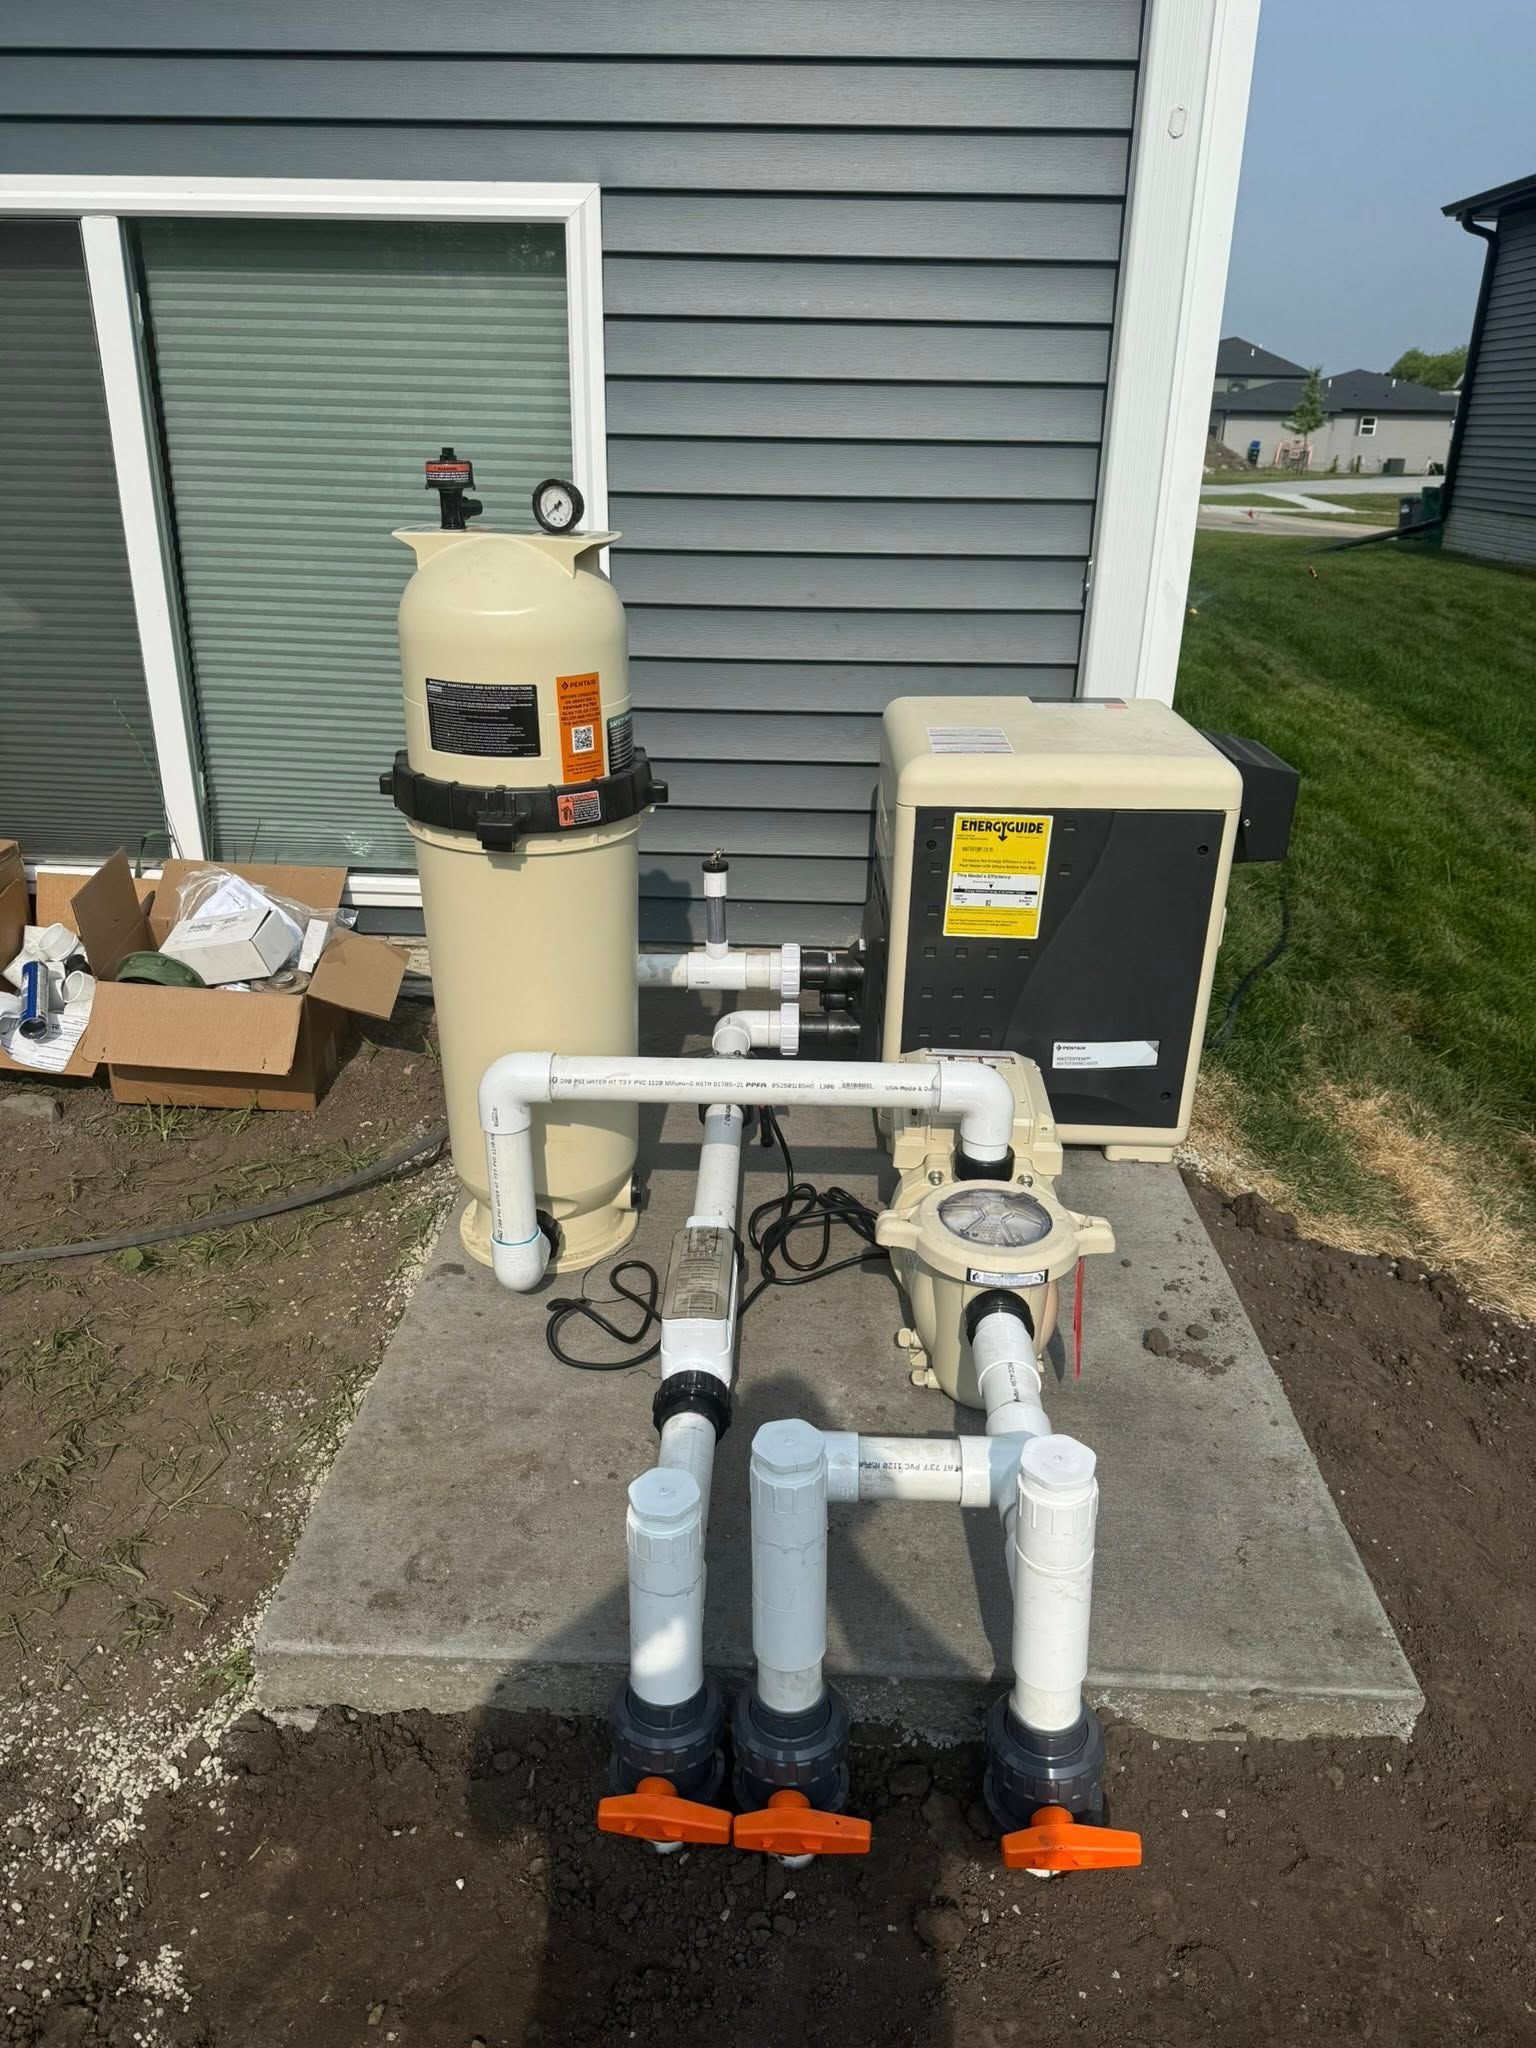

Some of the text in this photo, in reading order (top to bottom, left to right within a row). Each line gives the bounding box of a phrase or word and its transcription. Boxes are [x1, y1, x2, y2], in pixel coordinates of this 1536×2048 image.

[961, 820, 1044, 834] ENERGYGUIDE
[882, 1462, 902, 1470] 1120
[904, 1462, 920, 1471] PVC
